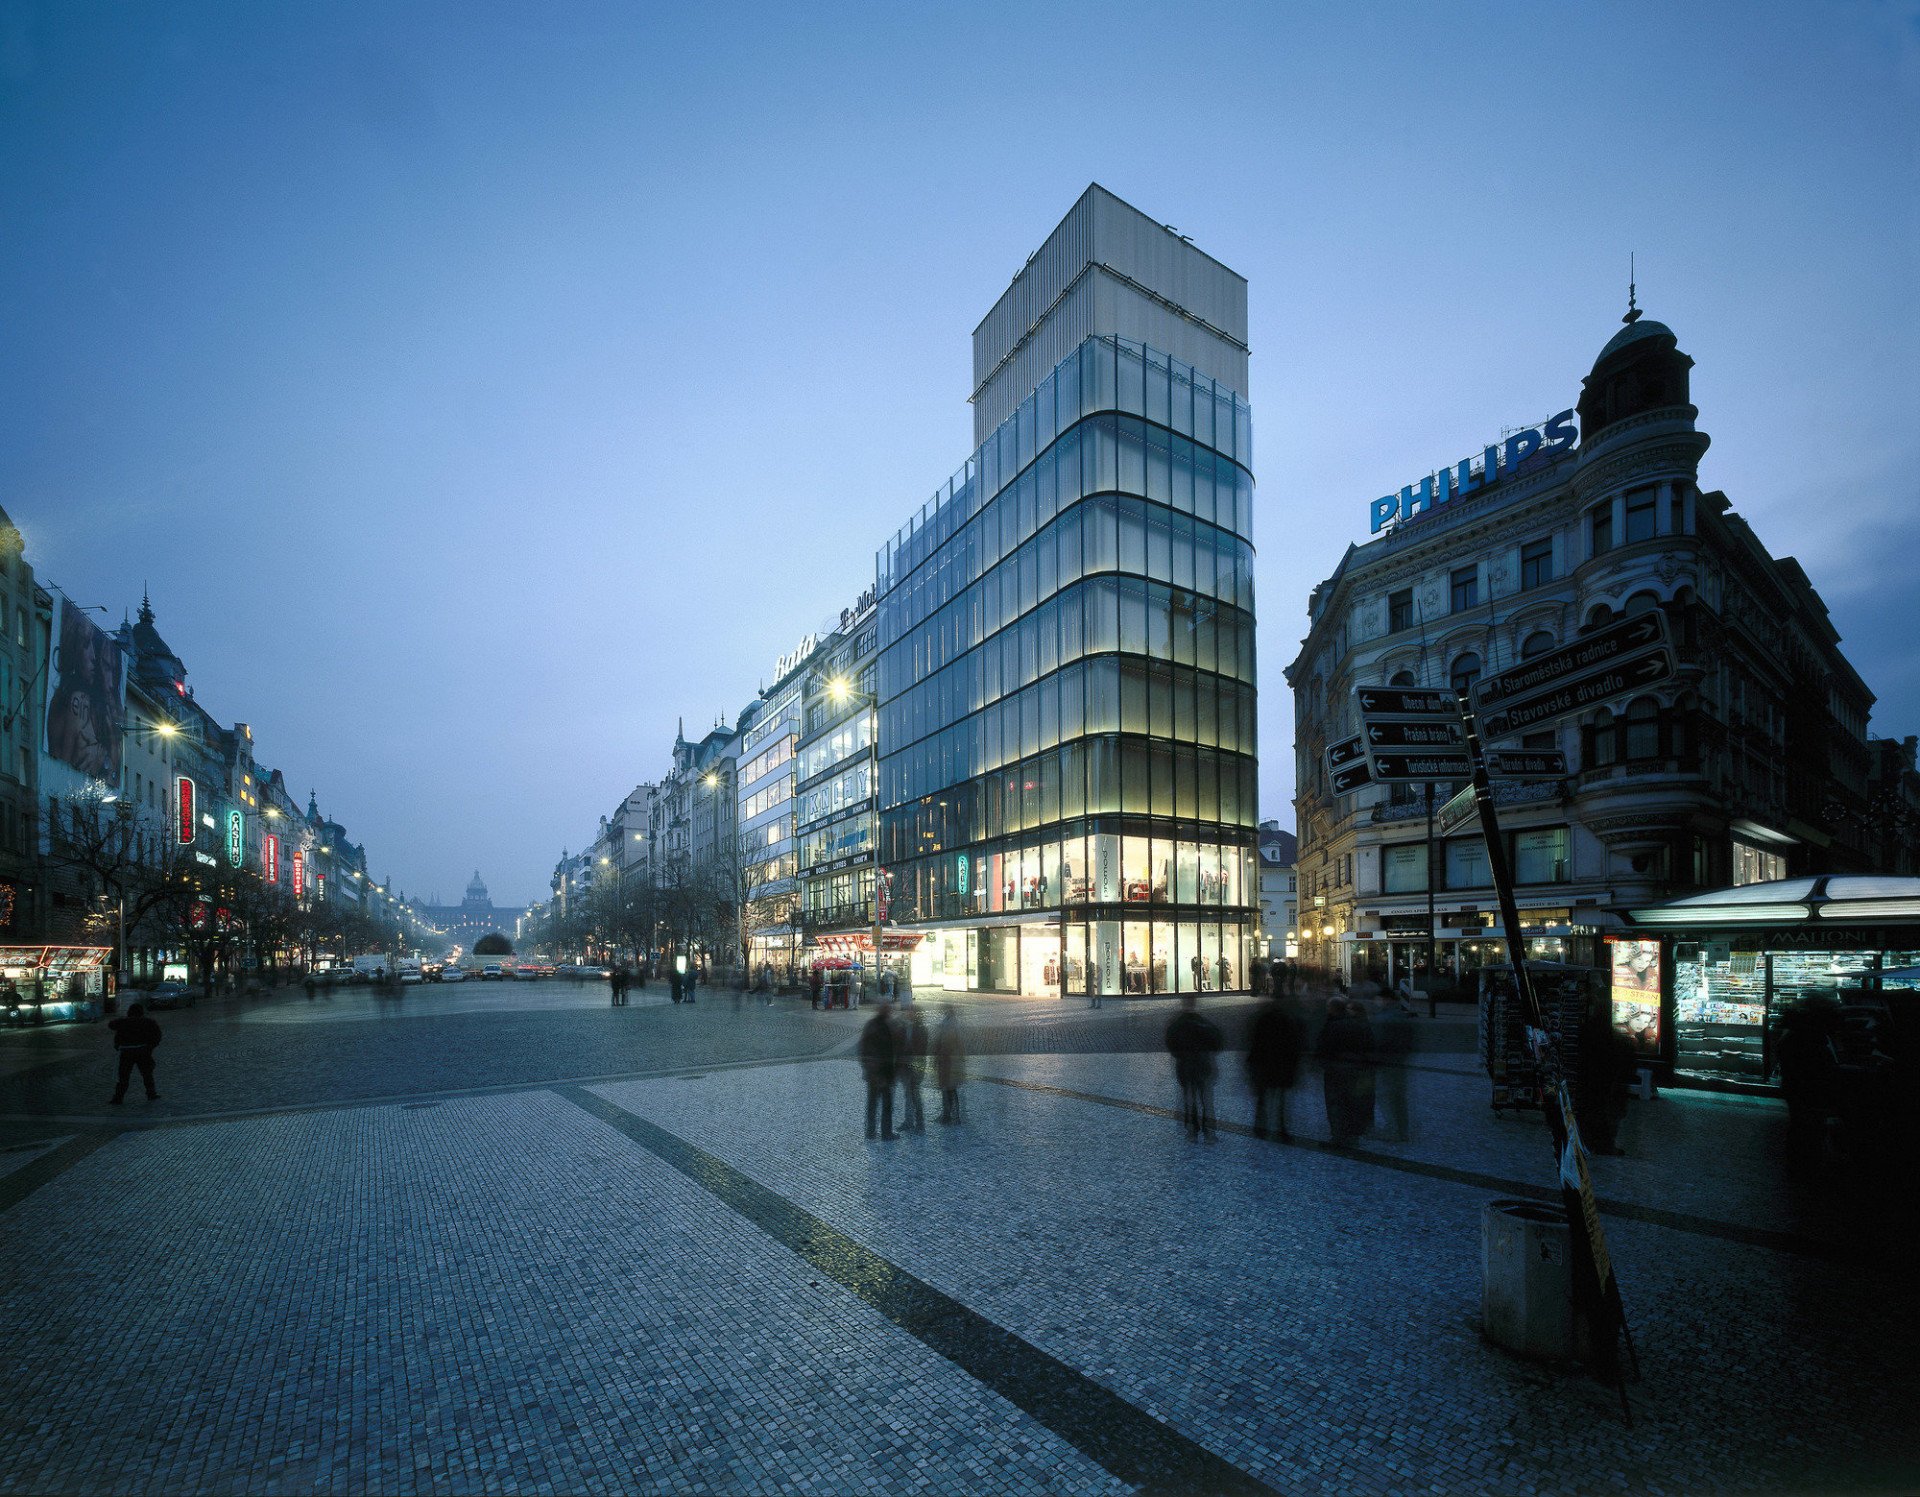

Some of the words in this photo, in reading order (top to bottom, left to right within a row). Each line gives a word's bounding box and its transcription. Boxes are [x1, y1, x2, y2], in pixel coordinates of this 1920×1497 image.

[1370, 407, 1579, 535] PHILIPS
[1503, 657, 1573, 694] Staroměstská
[1576, 639, 1618, 666] radnice
[1510, 692, 1572, 727] Stavovské
[1578, 674, 1624, 703] divadlo
[809, 767, 870, 816] KNIHY
[232, 814, 241, 863] CASINO
